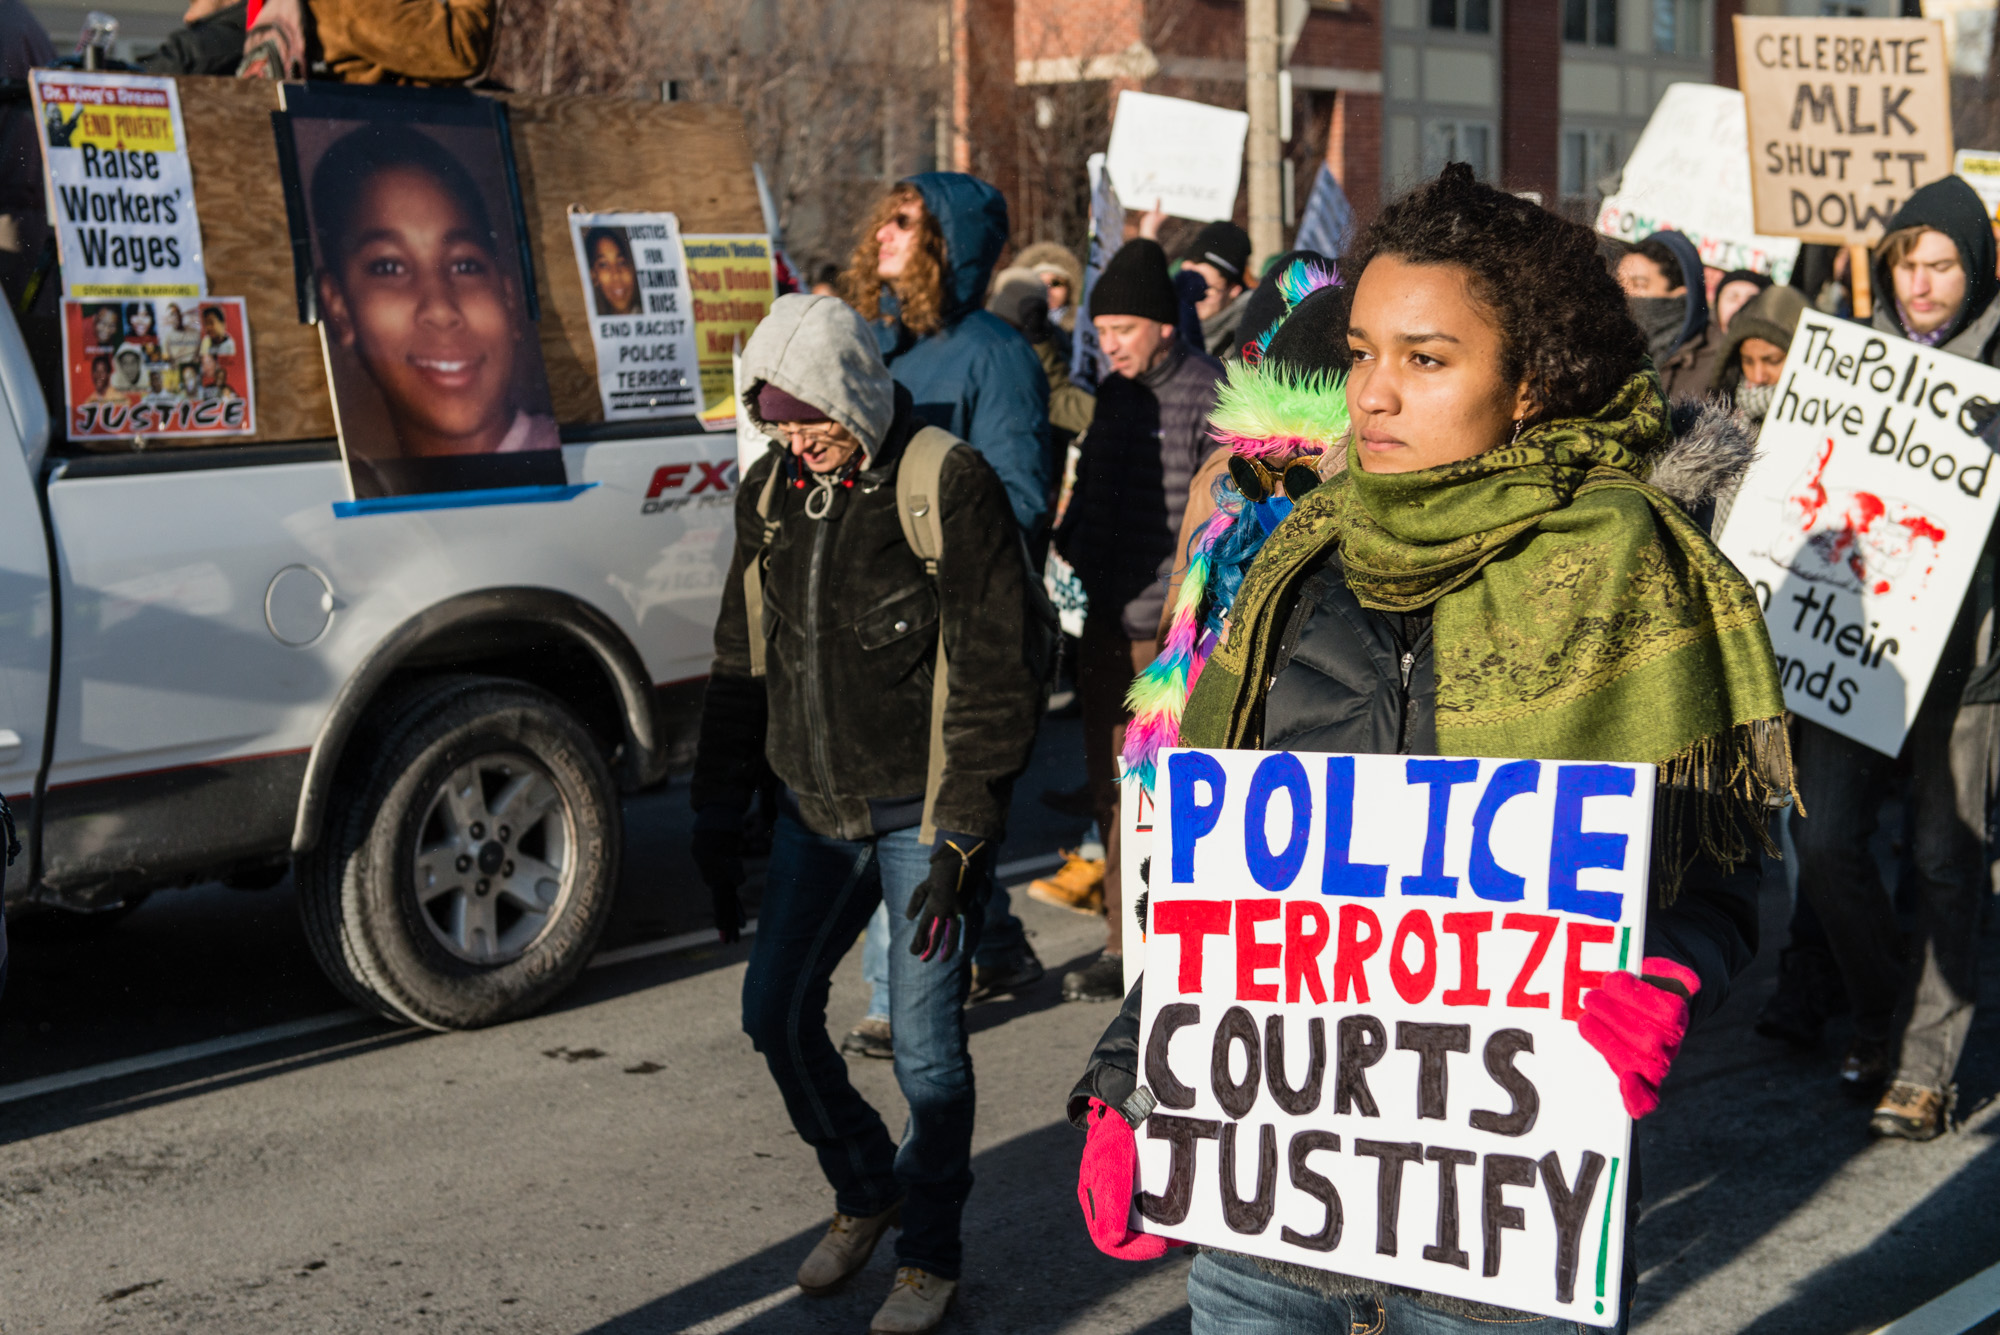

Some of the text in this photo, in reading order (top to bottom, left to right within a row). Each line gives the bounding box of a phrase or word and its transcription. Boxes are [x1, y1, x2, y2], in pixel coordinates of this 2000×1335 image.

[1755, 34, 1927, 74] CELEBRATE
[43, 85, 166, 105] Dr. King's Dream
[1790, 83, 1918, 136] MLK
[83, 113, 169, 139] END POVERTY
[82, 143, 160, 179] Raise
[1766, 141, 1851, 180] SHUT
[1873, 151, 1926, 189] IT
[60, 185, 182, 224] Workers'
[1791, 189, 1905, 231] DOW
[78, 228, 181, 272] Wages
[627, 225, 669, 240] JUSTICE
[643, 248, 664, 264] FOR
[637, 269, 678, 288] TAMIR
[649, 294, 678, 313] RICE
[601, 320, 685, 338] END RACIST
[619, 344, 676, 363] POLICE
[1804, 324, 1854, 380] The
[77, 400, 246, 432] JUSTICE
[1776, 372, 1994, 498] have blood
[1793, 586, 1899, 669] their
[1776, 652, 1859, 716] nds
[1168, 750, 1636, 923] POLICE
[1145, 1003, 1540, 1138] COURTS
[1135, 1114, 1620, 1315] JUSTIFY!
